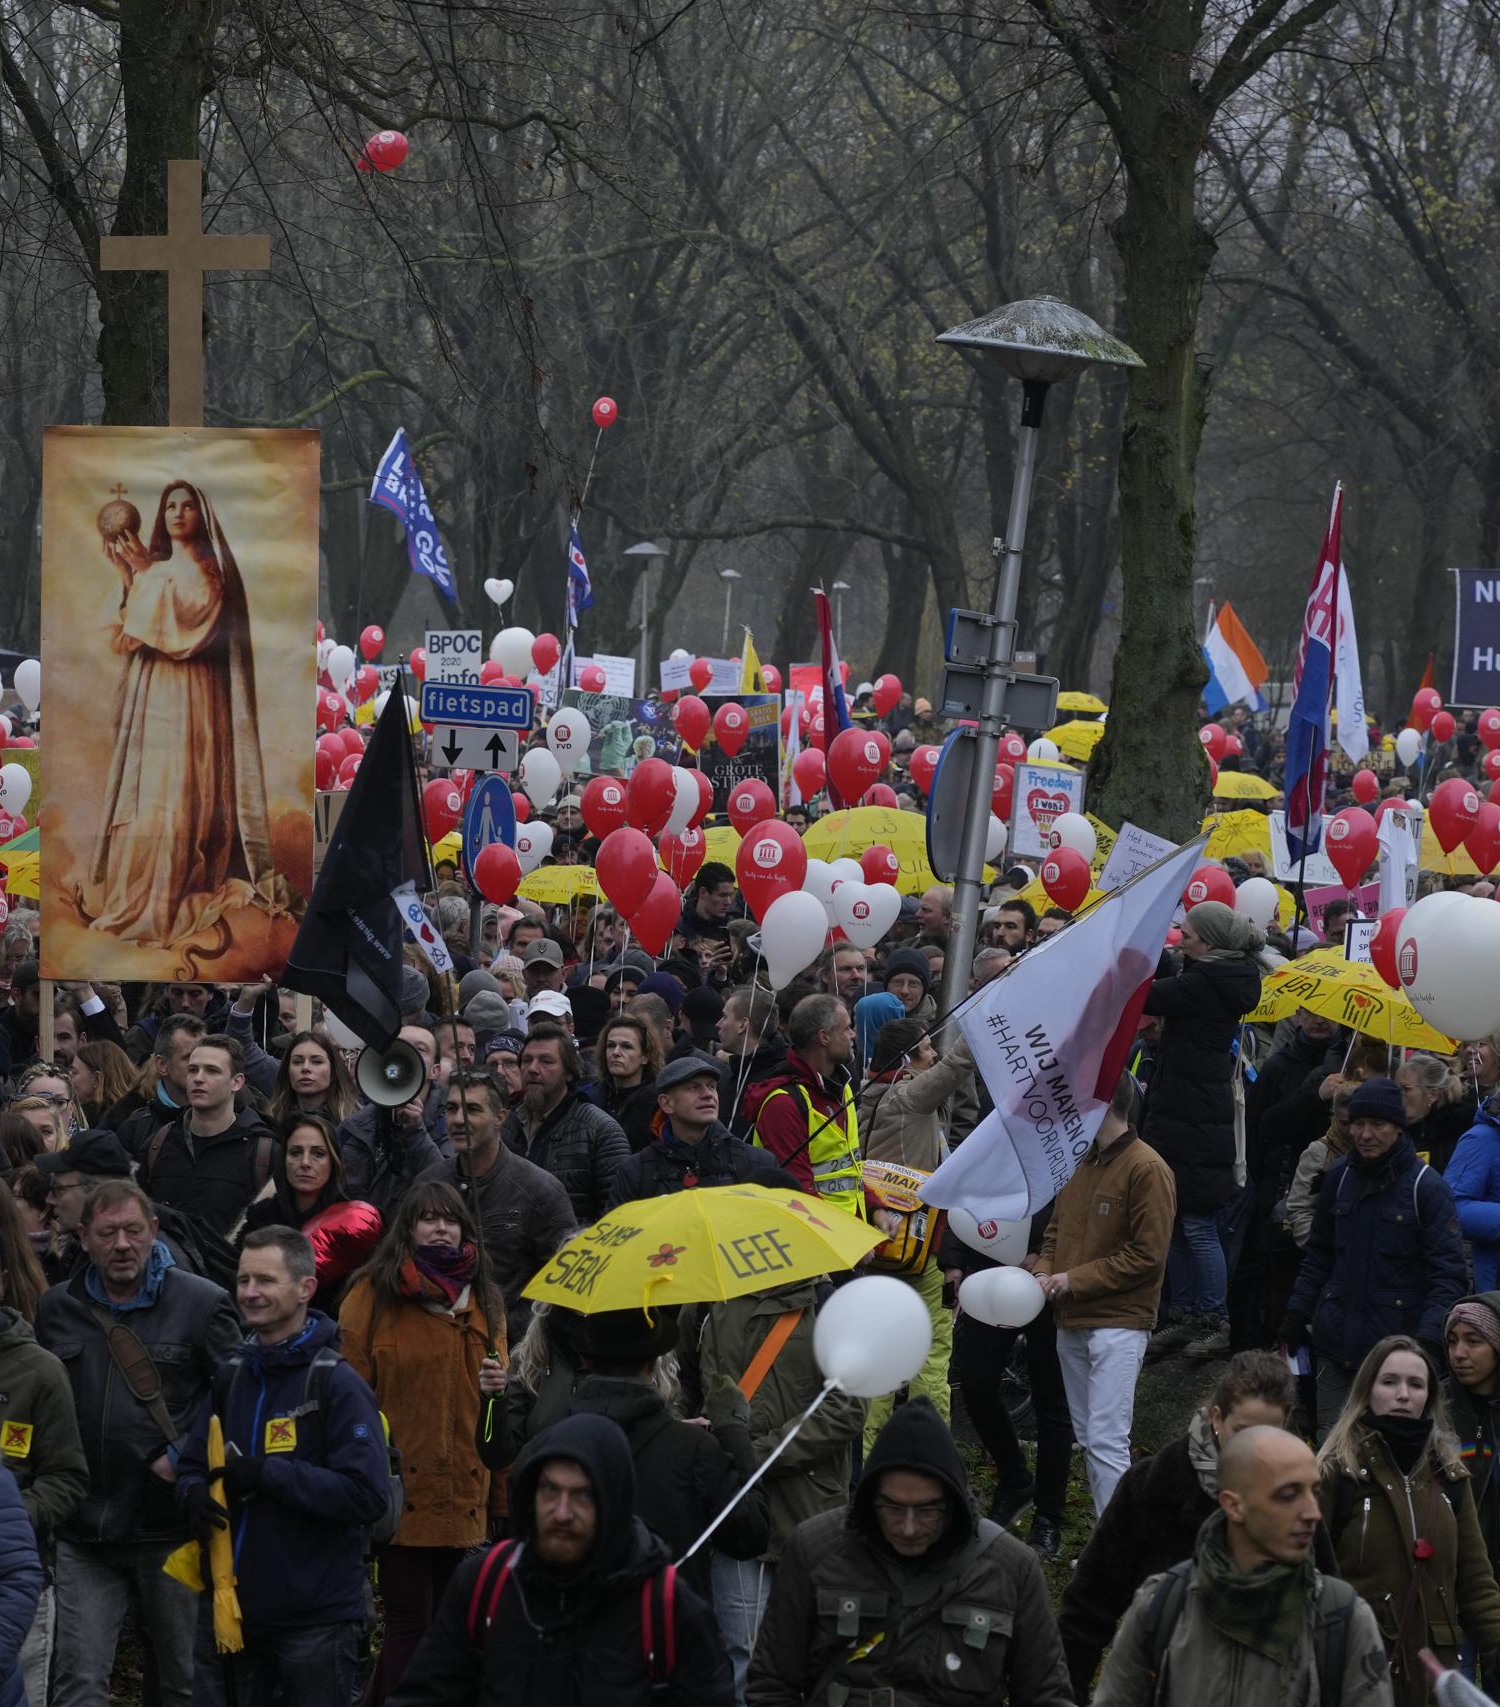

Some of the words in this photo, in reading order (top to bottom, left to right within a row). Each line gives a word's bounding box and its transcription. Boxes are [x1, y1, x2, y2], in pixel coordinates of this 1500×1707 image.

[429, 635, 480, 653] BPOC
[441, 657, 461, 666] 2020
[429, 691, 524, 721] fietspad
[714, 764, 764, 776] GROTE
[1027, 770, 1073, 791] Freedom
[1025, 1023, 1059, 1071] WIJ
[1046, 1074, 1085, 1143] MAKEN
[718, 1229, 795, 1279] LEEF
[545, 1248, 611, 1297] STERK
